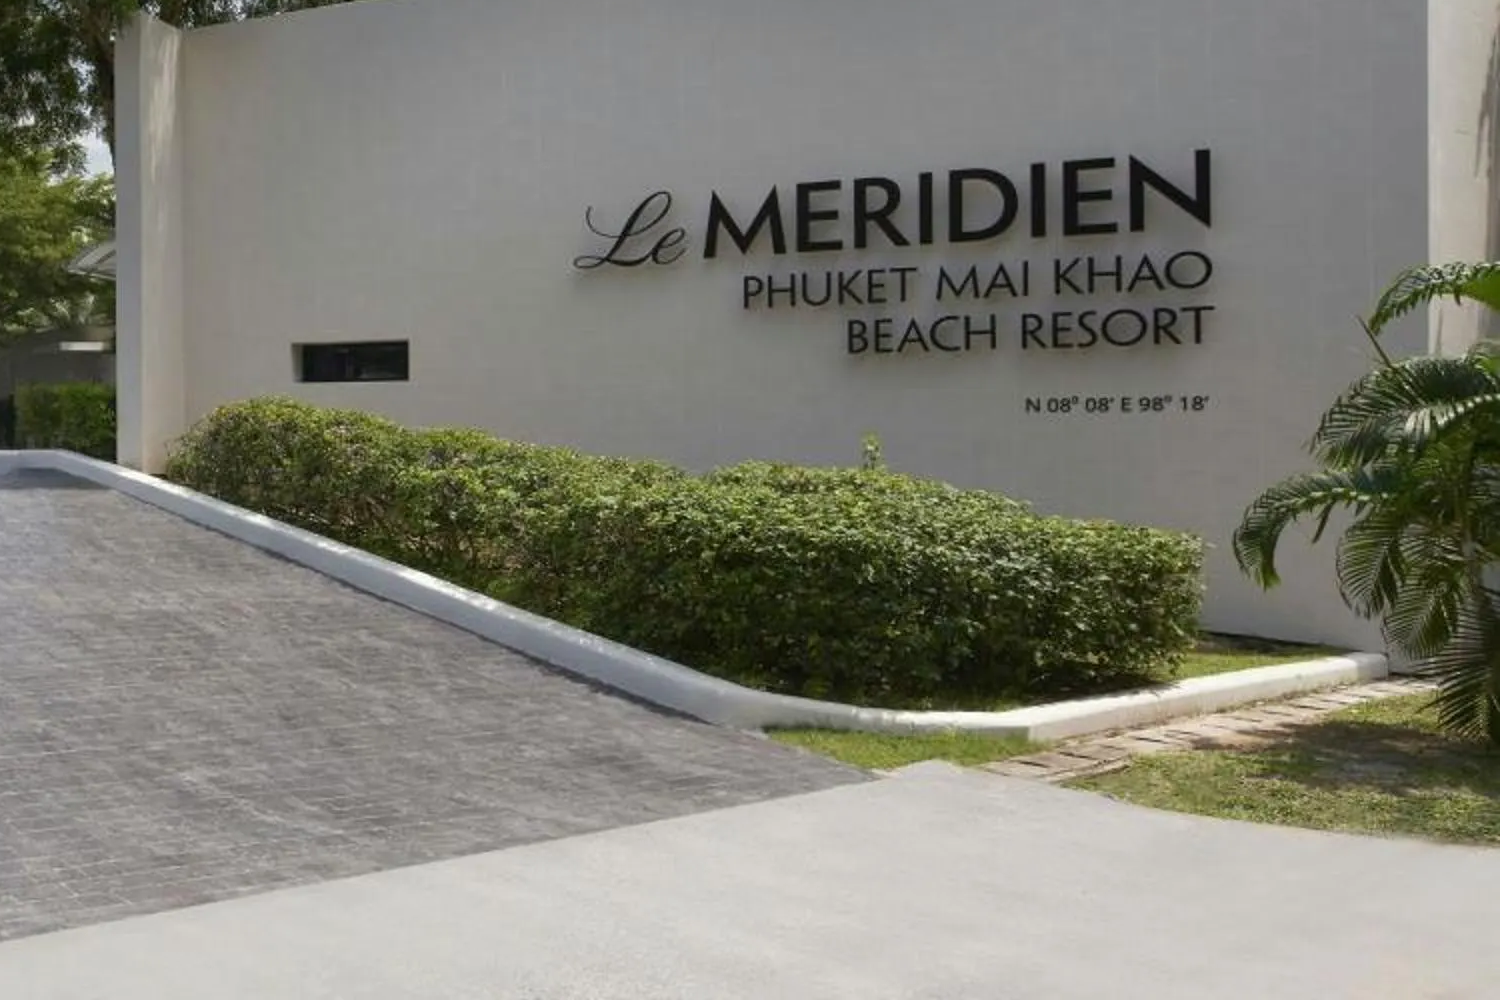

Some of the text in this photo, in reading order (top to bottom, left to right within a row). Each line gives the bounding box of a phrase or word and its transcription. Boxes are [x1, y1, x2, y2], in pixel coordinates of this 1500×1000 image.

[573, 149, 1212, 270] Le MERIDIEN
[743, 250, 1213, 310] PHUKET MAI KHAO
[847, 305, 1215, 354] BEACH RESORT
[1025, 396, 1041, 413] N
[1121, 397, 1134, 413] E
